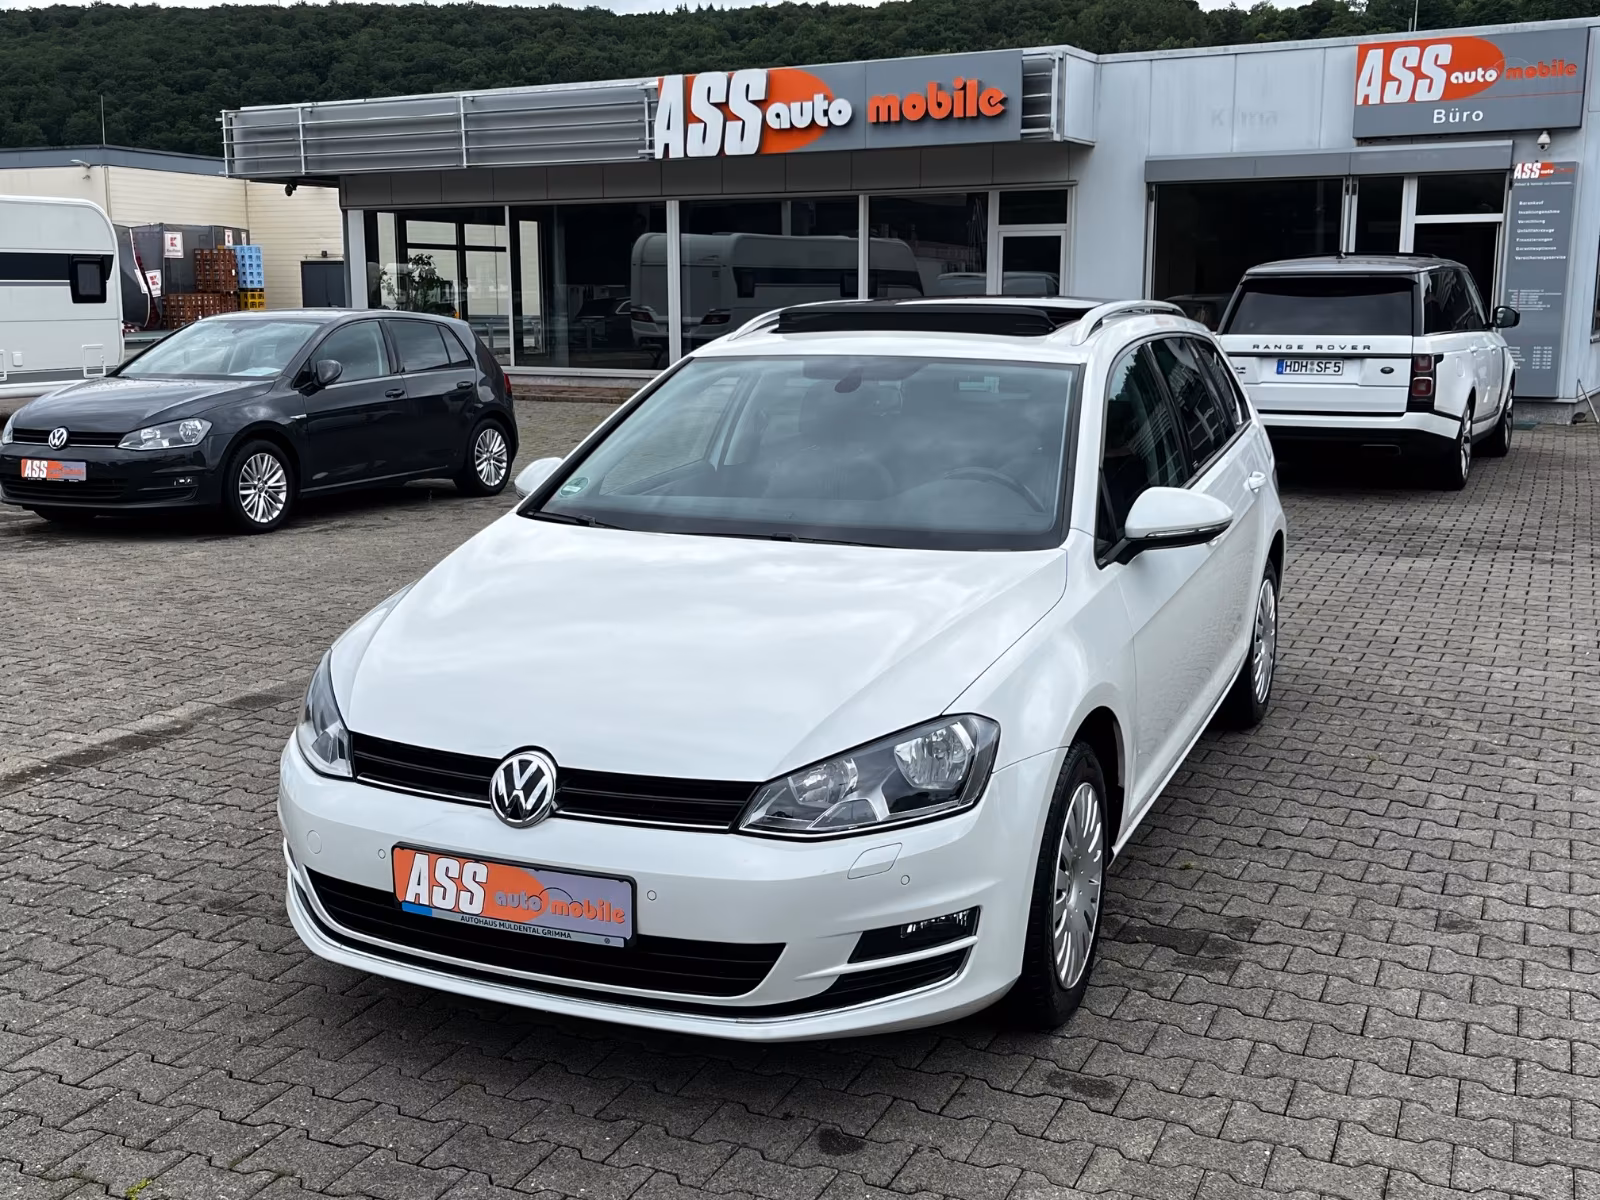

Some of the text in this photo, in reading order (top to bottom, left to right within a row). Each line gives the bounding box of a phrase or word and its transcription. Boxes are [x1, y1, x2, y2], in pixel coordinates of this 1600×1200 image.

[1356, 43, 1578, 106] ASS auto mobile
[654, 68, 1007, 159] ASS auto mobile
[1432, 107, 1484, 124] Büro
[1514, 163, 1541, 179] ASS
[1284, 360, 1341, 373] HDH SF 5
[25, 460, 48, 478] ASS
[405, 852, 625, 924] ASS auto mobile
[460, 914, 572, 939] AUTOHAUS MULDENTAL GRIMMA
